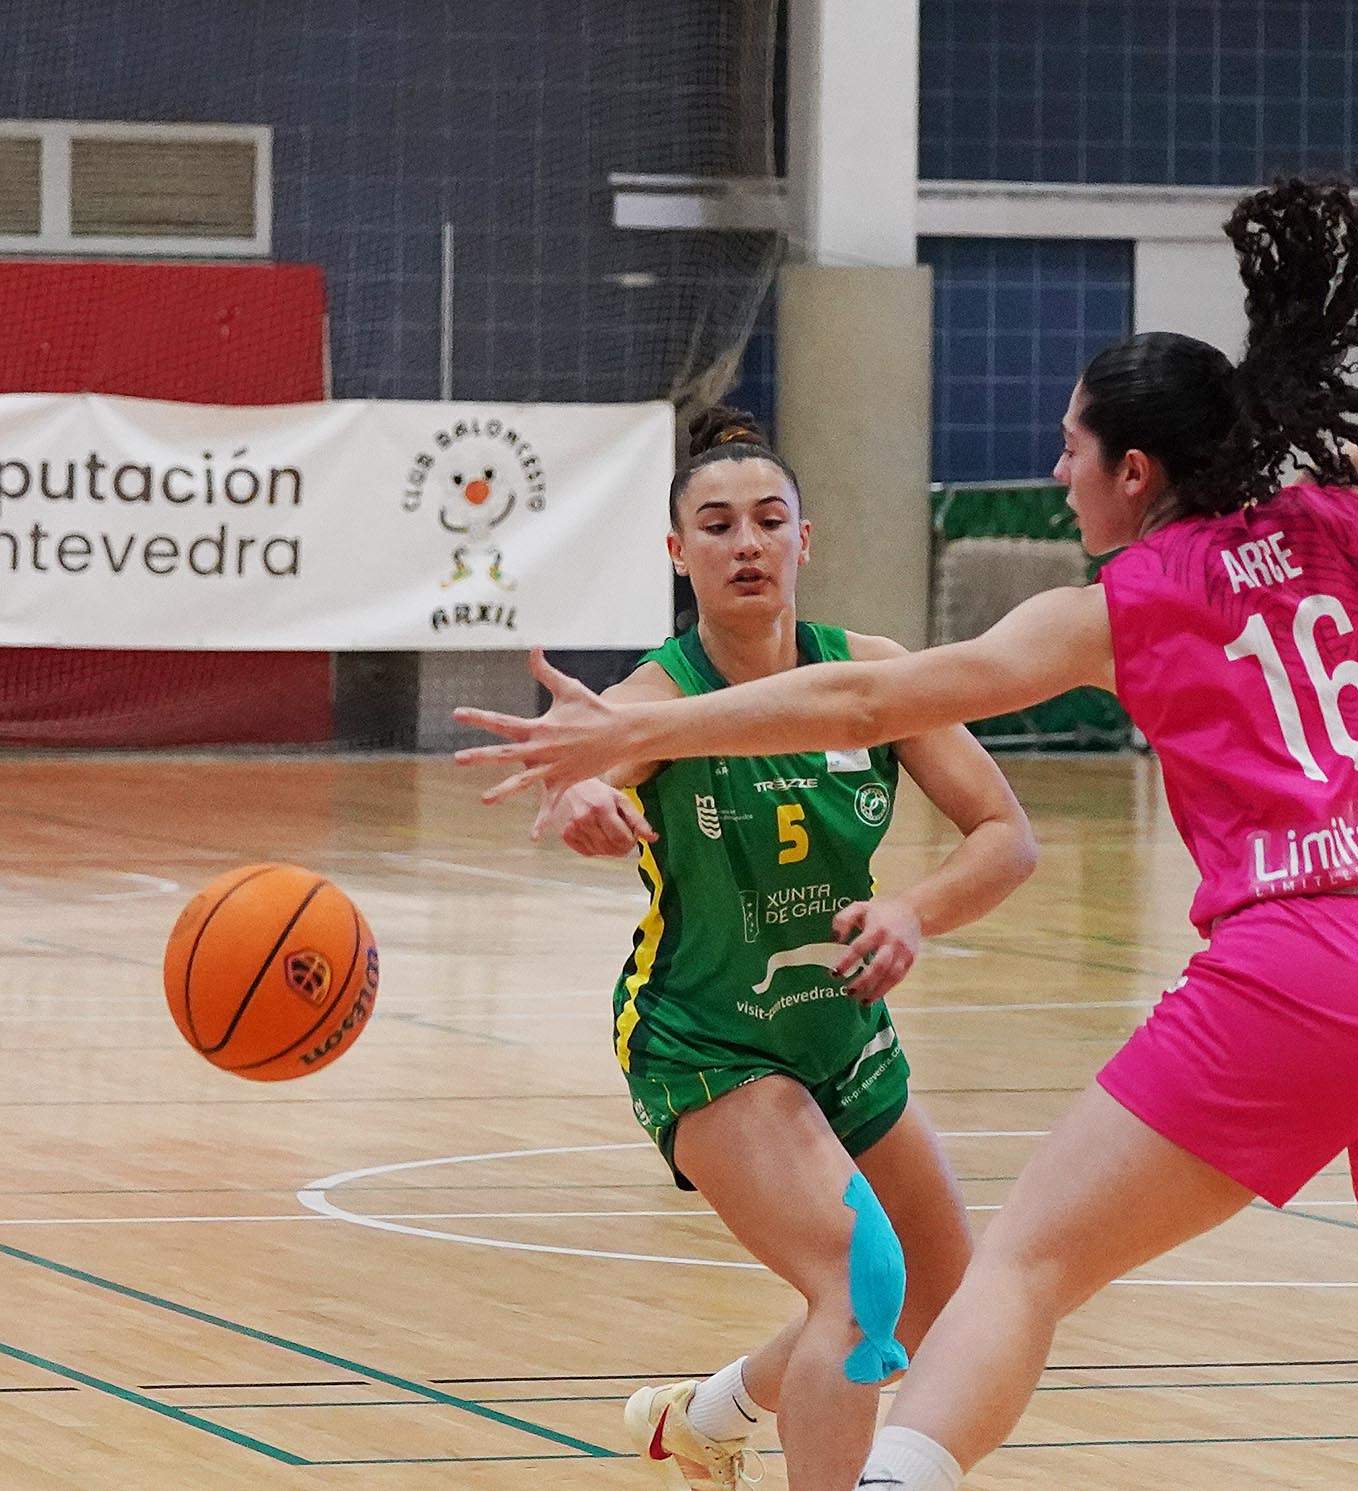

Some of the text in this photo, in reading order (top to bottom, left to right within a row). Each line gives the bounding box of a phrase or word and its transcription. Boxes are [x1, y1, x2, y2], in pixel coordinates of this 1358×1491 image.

[776, 803, 809, 865] 5
[767, 883, 831, 909] XUNTA
[765, 907, 790, 924] DE
